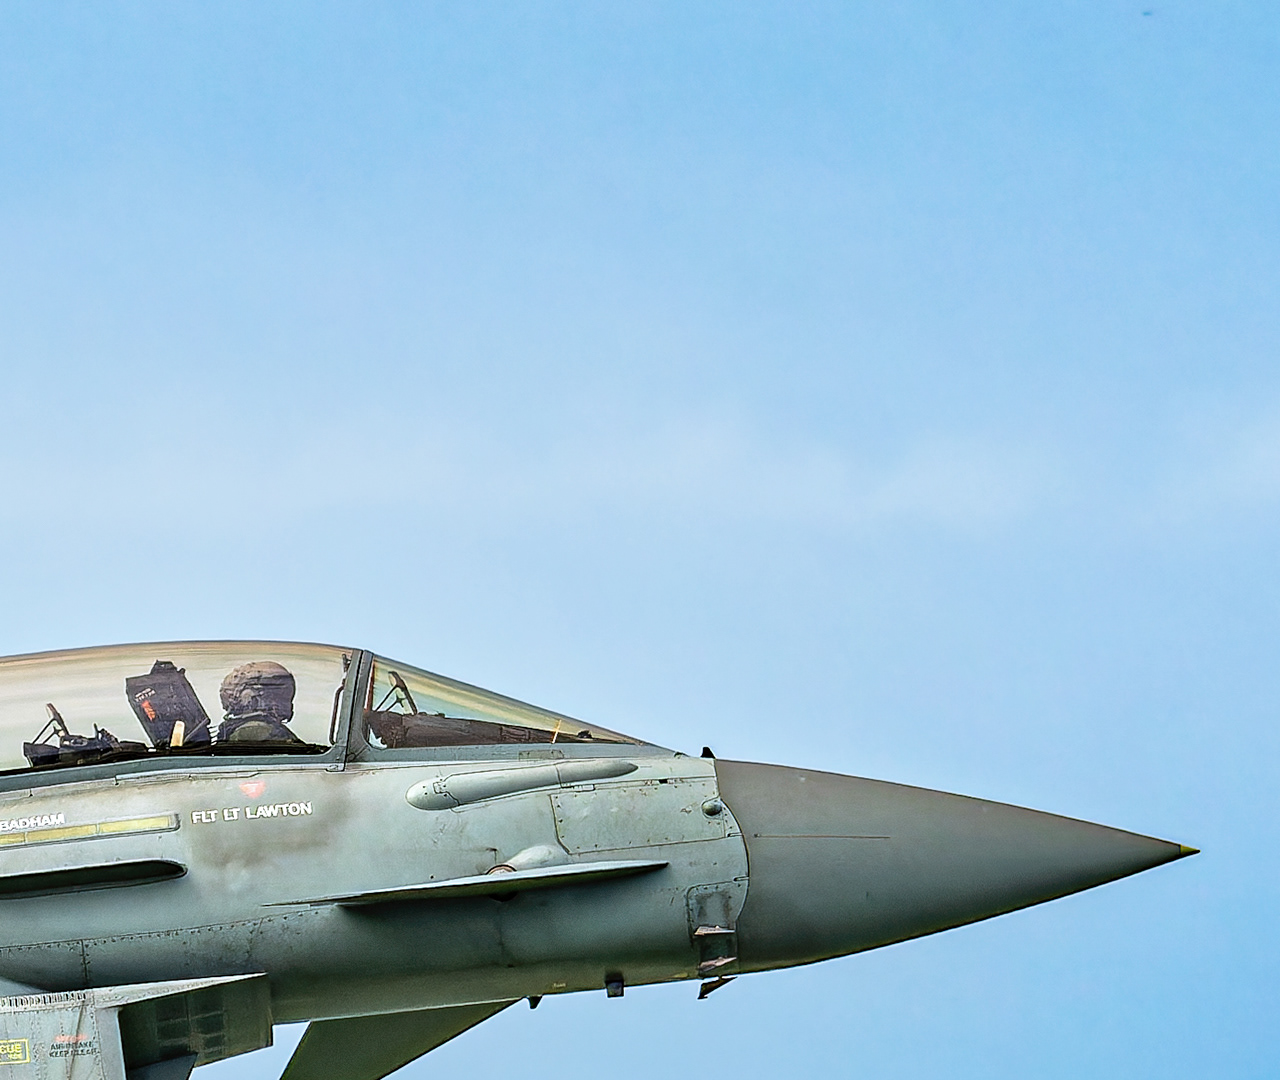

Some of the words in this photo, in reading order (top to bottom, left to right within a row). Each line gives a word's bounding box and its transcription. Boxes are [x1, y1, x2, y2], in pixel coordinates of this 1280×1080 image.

[191, 810, 218, 824] FLT
[222, 807, 240, 821] LT
[245, 801, 313, 819] LAWTON
